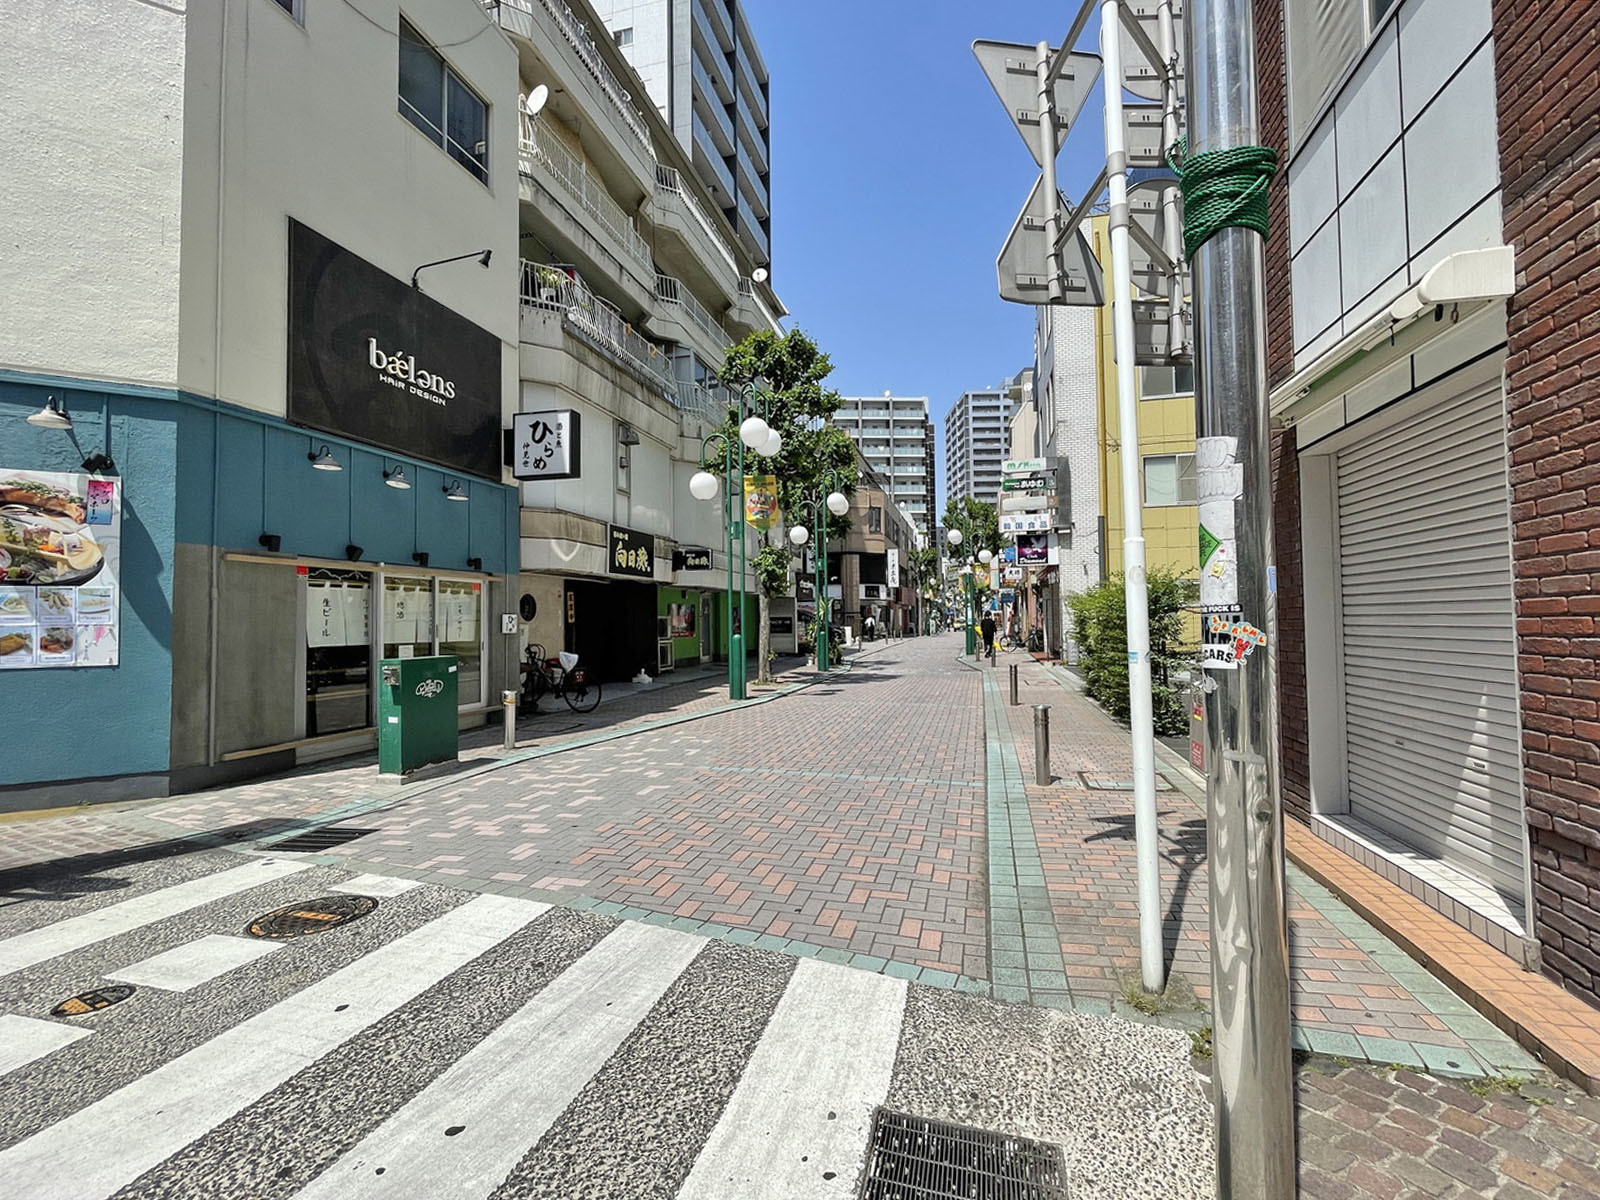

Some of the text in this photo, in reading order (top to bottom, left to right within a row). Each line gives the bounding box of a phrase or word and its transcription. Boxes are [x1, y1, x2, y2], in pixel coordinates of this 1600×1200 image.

[379, 373, 447, 406] HAIR DESIGN
[529, 420, 554, 470] ひらめ
[1003, 521, 1048, 530] 韓国食品
[322, 598, 331, 637] 生ビール
[1208, 605, 1230, 613] FUCK
[1230, 604, 1241, 612] IS
